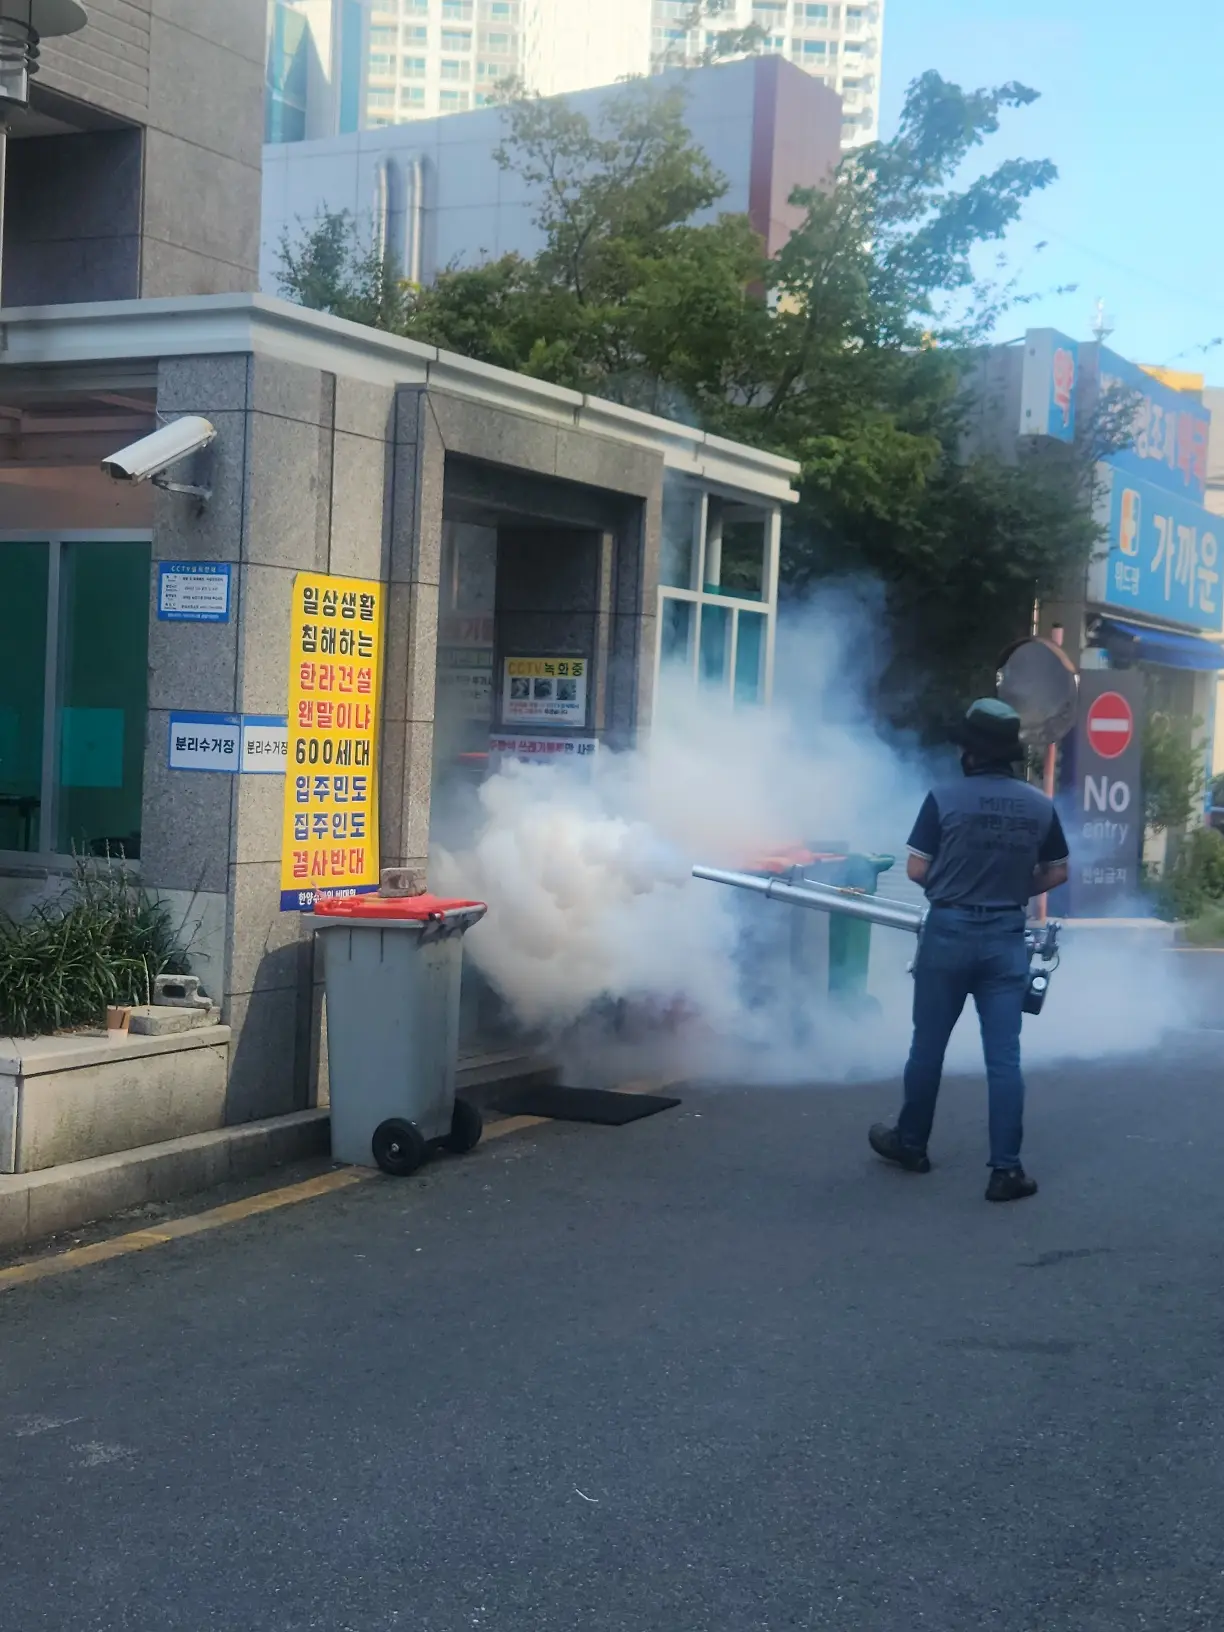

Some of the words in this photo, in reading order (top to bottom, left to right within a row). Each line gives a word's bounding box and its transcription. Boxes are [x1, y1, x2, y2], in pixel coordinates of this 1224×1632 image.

[1053, 347, 1075, 428] 약
[1150, 514, 1219, 614] 가까운
[303, 587, 375, 621] 일상생활
[301, 624, 373, 658] 침해하는
[299, 661, 372, 694] 한라건설
[544, 662, 583, 677] 녹화중
[175, 736, 236, 755] 분리수거장
[295, 738, 370, 766] 600세대
[295, 775, 367, 803] 입주민도
[1083, 774, 1131, 813] No
[294, 812, 366, 841] 집주인도
[1082, 820, 1129, 846] entry
[292, 848, 365, 879] 결사반대
